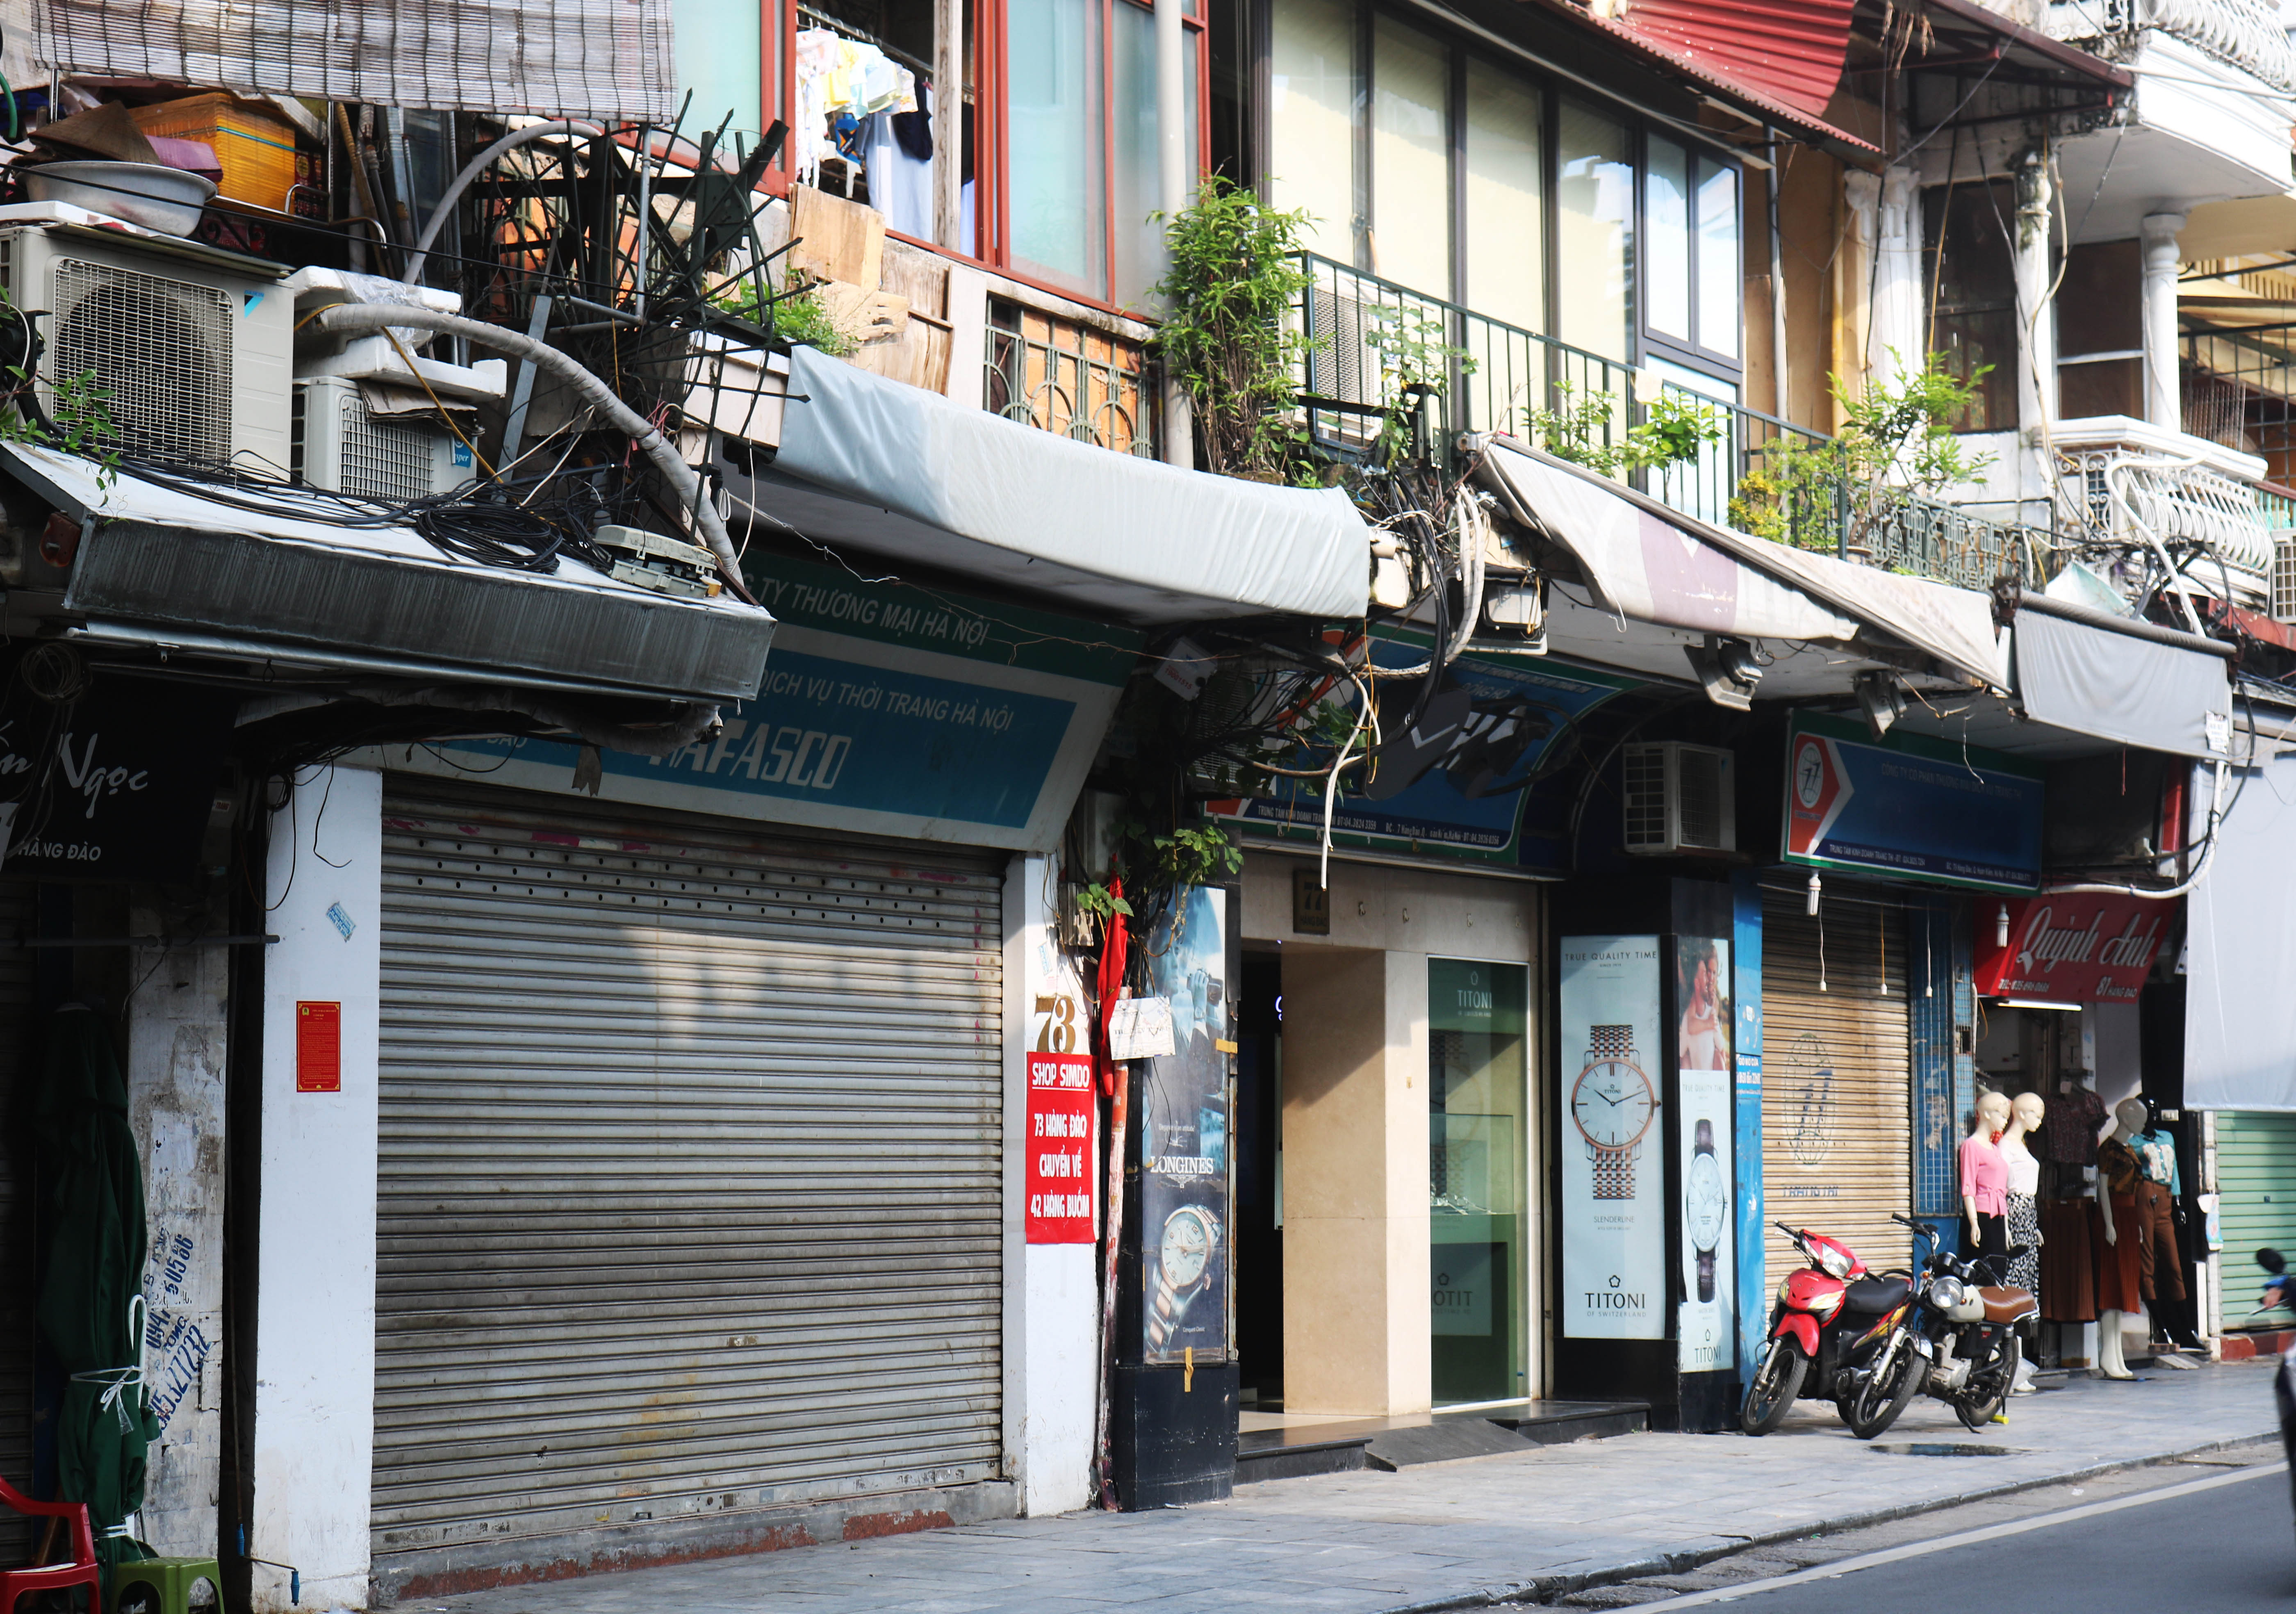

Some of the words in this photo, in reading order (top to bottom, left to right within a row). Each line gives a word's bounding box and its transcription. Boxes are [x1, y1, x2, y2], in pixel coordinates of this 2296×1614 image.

[758, 577, 788, 605] TY
[791, 583, 879, 625] THƯƠNG
[880, 604, 920, 637] MẠI
[952, 616, 990, 650] NỘI
[806, 677, 835, 707] VỤ
[837, 681, 884, 710] THỜI
[886, 691, 950, 720] TRANG
[950, 698, 979, 726] HÀ
[979, 704, 1014, 734] NỘI
[41, 732, 148, 819] Ngọc
[66, 841, 102, 862] ĐÀO
[2099, 913, 2162, 968] Anh
[1565, 953, 1587, 962] TRUE
[1591, 952, 1631, 961] QUALITY
[1635, 951, 1657, 959] TIME
[1457, 990, 1492, 1008] TITONI
[1034, 992, 1076, 1053] 73
[1032, 1062, 1057, 1086] SHOP
[1059, 1063, 1090, 1088] SIMDO
[1034, 1113, 1044, 1137] 73
[1046, 1109, 1067, 1138] HÀNG
[1069, 1109, 1087, 1138] ĐÀO
[1039, 1144, 1071, 1178] CHUYỂN
[1150, 1156, 1214, 1175] LONGINES
[1030, 1194, 1042, 1218] 42
[1043, 1189, 1065, 1218] HÀNG
[1585, 1293, 1645, 1309] TITONI
[1695, 1345, 1721, 1363] TITONI
